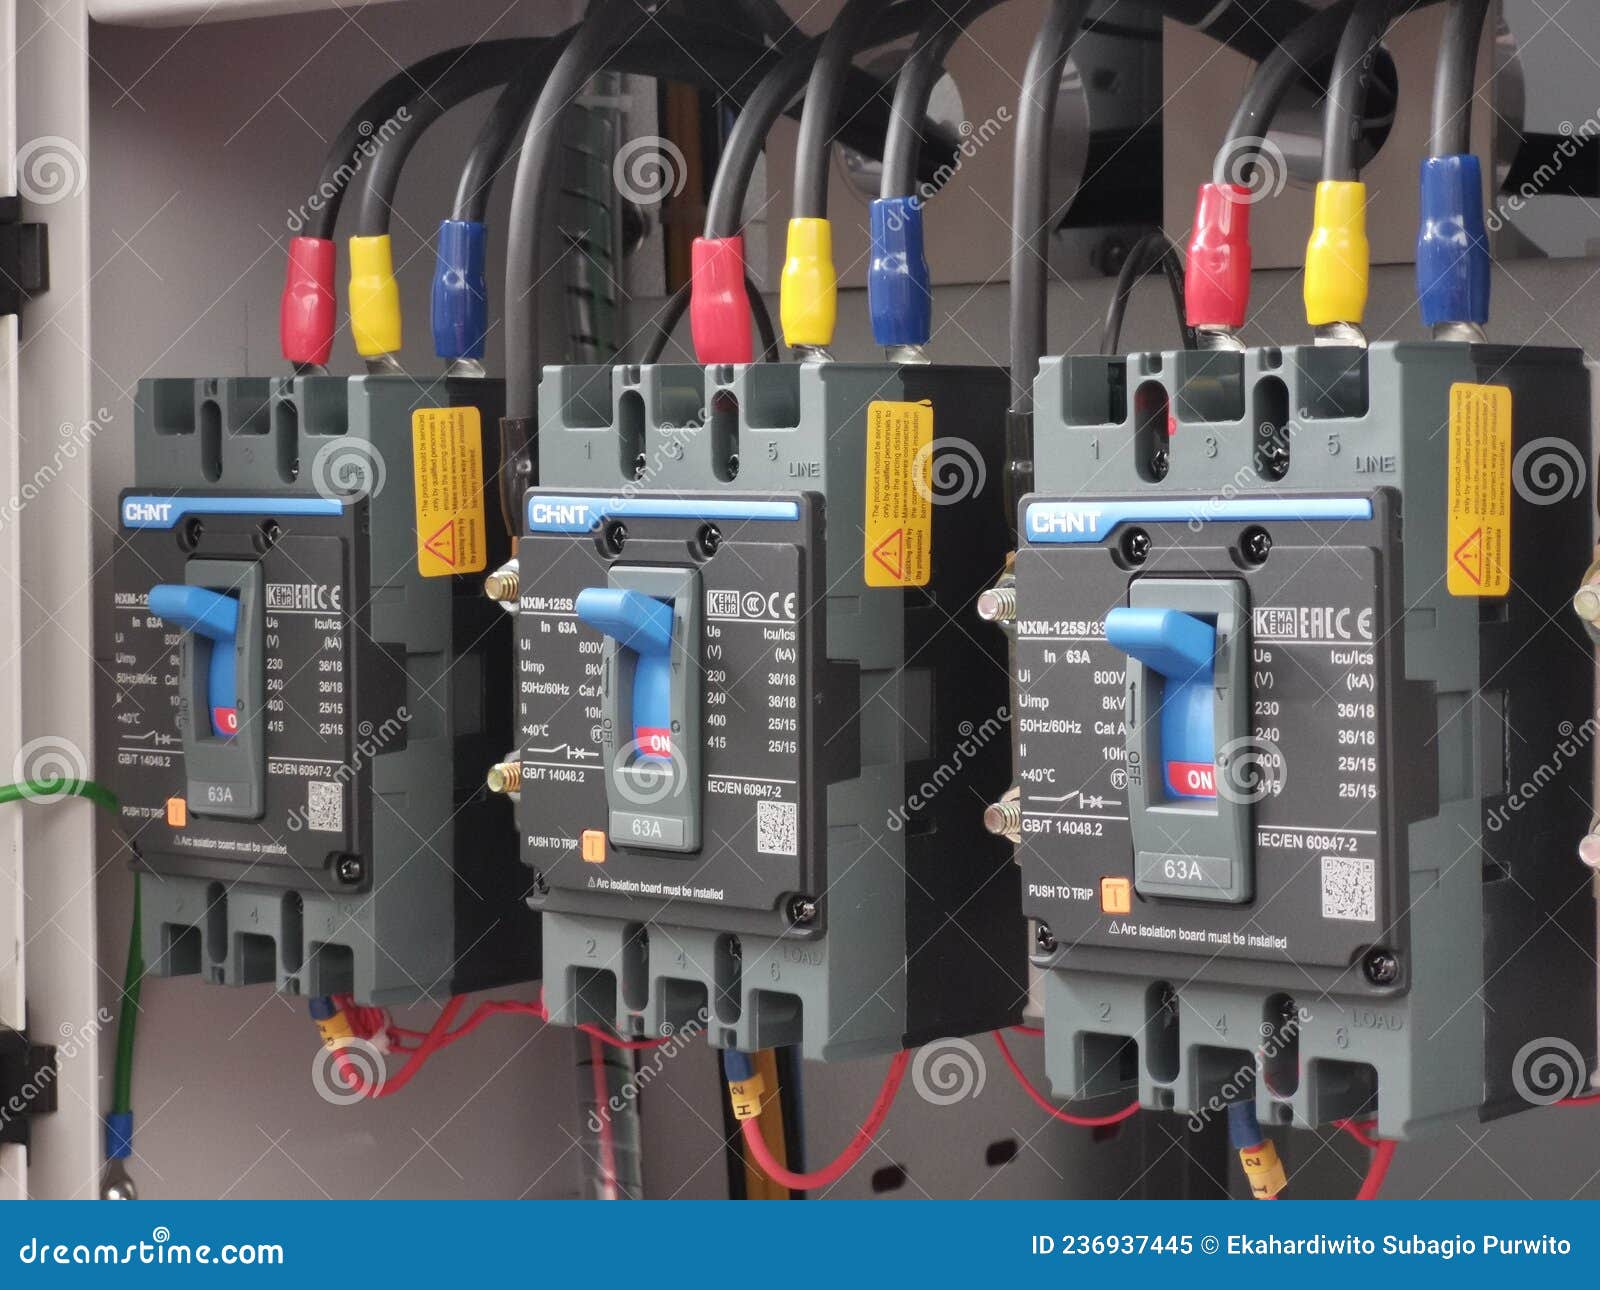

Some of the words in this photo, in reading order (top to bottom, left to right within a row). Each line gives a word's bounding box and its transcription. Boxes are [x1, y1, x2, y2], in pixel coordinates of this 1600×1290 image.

[767, 441, 778, 461] 5
[1090, 438, 1101, 460] 1
[1204, 437, 1219, 459] 3
[1327, 433, 1341, 456] 5
[790, 462, 821, 478] LINE
[1353, 454, 1397, 474] LINE
[558, 622, 578, 634] 63A
[1017, 620, 1106, 635] NXM-125S/33
[1335, 607, 1373, 640] CE
[706, 625, 721, 638] Ue
[763, 627, 796, 641] Icu/Ics
[520, 639, 531, 651] Ui
[579, 641, 604, 654] 800V
[706, 644, 722, 660] (V)
[775, 647, 796, 664] (kA)
[267, 658, 283, 670] 230
[319, 660, 343, 673] 36/18
[1043, 649, 1057, 664] In
[1066, 650, 1091, 664] 63A
[1254, 649, 1272, 663] Ue
[1331, 650, 1375, 665] Icu/Ics
[520, 660, 545, 676] Uimp
[267, 678, 284, 691] 240
[319, 681, 344, 694] 36/18
[707, 670, 726, 682] 230
[768, 672, 796, 686] 36/18
[1018, 670, 1031, 683] Ui
[1093, 671, 1126, 685] 800V
[1254, 672, 1274, 689] (V)
[1346, 673, 1375, 692] (kA)
[521, 683, 570, 696] 50Hz/60Hz
[578, 684, 596, 698] Cat
[267, 700, 284, 712] 400
[319, 702, 344, 714] 25/15
[707, 691, 726, 705] 240
[768, 695, 797, 709] 36/18
[1018, 694, 1050, 711] Uimp
[1102, 696, 1126, 710] 8kV
[1255, 701, 1280, 716] 230
[1337, 703, 1376, 719] 36/18
[267, 720, 285, 733] 415
[320, 723, 344, 736] 25/15
[707, 713, 727, 727] 400
[768, 718, 797, 732] 25/15
[1019, 719, 1083, 734] 50Hz/60Hz
[1094, 721, 1115, 735] Cat
[1117, 722, 1127, 735] A
[650, 734, 671, 753] ON
[707, 735, 727, 749] 415
[768, 739, 797, 754] 25/15
[1255, 727, 1280, 742] 240
[1338, 730, 1376, 746] 36/18
[268, 762, 298, 776] IEC/EN
[299, 764, 332, 777] 60947-2
[1128, 751, 1142, 786] OFF
[1255, 753, 1281, 768] 400
[1338, 757, 1377, 773] 25/15
[522, 767, 545, 780] GB/T
[548, 769, 585, 783] 14048.2
[1187, 770, 1213, 790] ON
[208, 786, 234, 802] 63A
[707, 780, 742, 795] IEC/EN
[743, 783, 782, 798] 60947-2
[1256, 779, 1281, 795] 415
[1338, 783, 1377, 799] 25/15
[632, 818, 663, 838] 63A
[1022, 819, 1052, 833] GB/T
[1056, 821, 1103, 837] 14048.2
[527, 835, 549, 848] PUSH
[549, 836, 560, 849] TO
[560, 838, 579, 850] TRIP
[1257, 832, 1303, 850] IEC/EN
[1306, 835, 1358, 853] 60947-2
[1164, 860, 1203, 881] 63A
[596, 877, 610, 890] Arc
[610, 878, 639, 893] isolation
[640, 880, 663, 895] board
[663, 884, 682, 896] must
[682, 885, 693, 897] be
[693, 887, 725, 901] installed
[1028, 884, 1056, 898] PUSH
[1056, 886, 1071, 900] TO
[1071, 886, 1094, 901] TRIP
[1120, 923, 1138, 936] Arc
[1139, 923, 1177, 940] isolation
[1178, 927, 1206, 943] board
[1208, 931, 1232, 945] must
[1233, 932, 1246, 946] be
[1247, 935, 1288, 950] installed
[585, 937, 598, 958] 2
[674, 951, 687, 969] 4
[769, 962, 781, 981] 6
[1098, 1001, 1113, 1023] 2
[1351, 1010, 1404, 1032] LOAD
[1214, 1013, 1228, 1036] 4
[1335, 1026, 1349, 1049] 6
